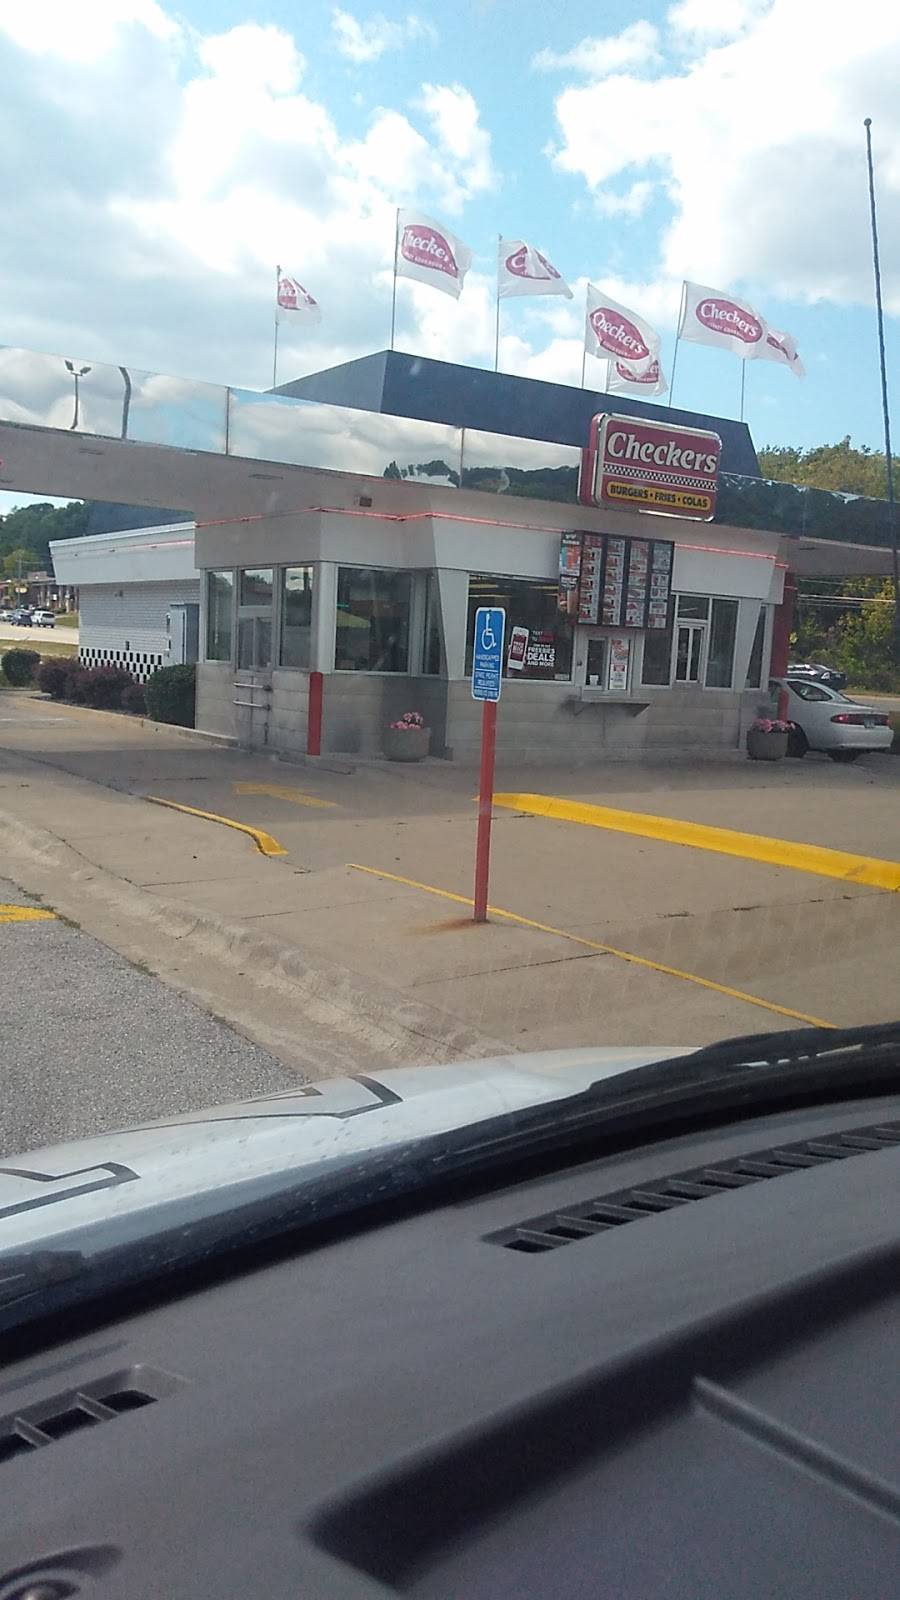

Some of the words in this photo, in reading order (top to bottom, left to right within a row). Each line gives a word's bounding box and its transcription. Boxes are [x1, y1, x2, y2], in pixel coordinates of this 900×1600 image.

[593, 312, 643, 354] Checkers
[701, 303, 759, 337] Checkers
[607, 431, 718, 474] Checkers
[610, 485, 649, 500] BURGERS
[654, 491, 676, 504] FRIES
[682, 496, 708, 508] COLAS
[527, 652, 556, 662] DEALS
